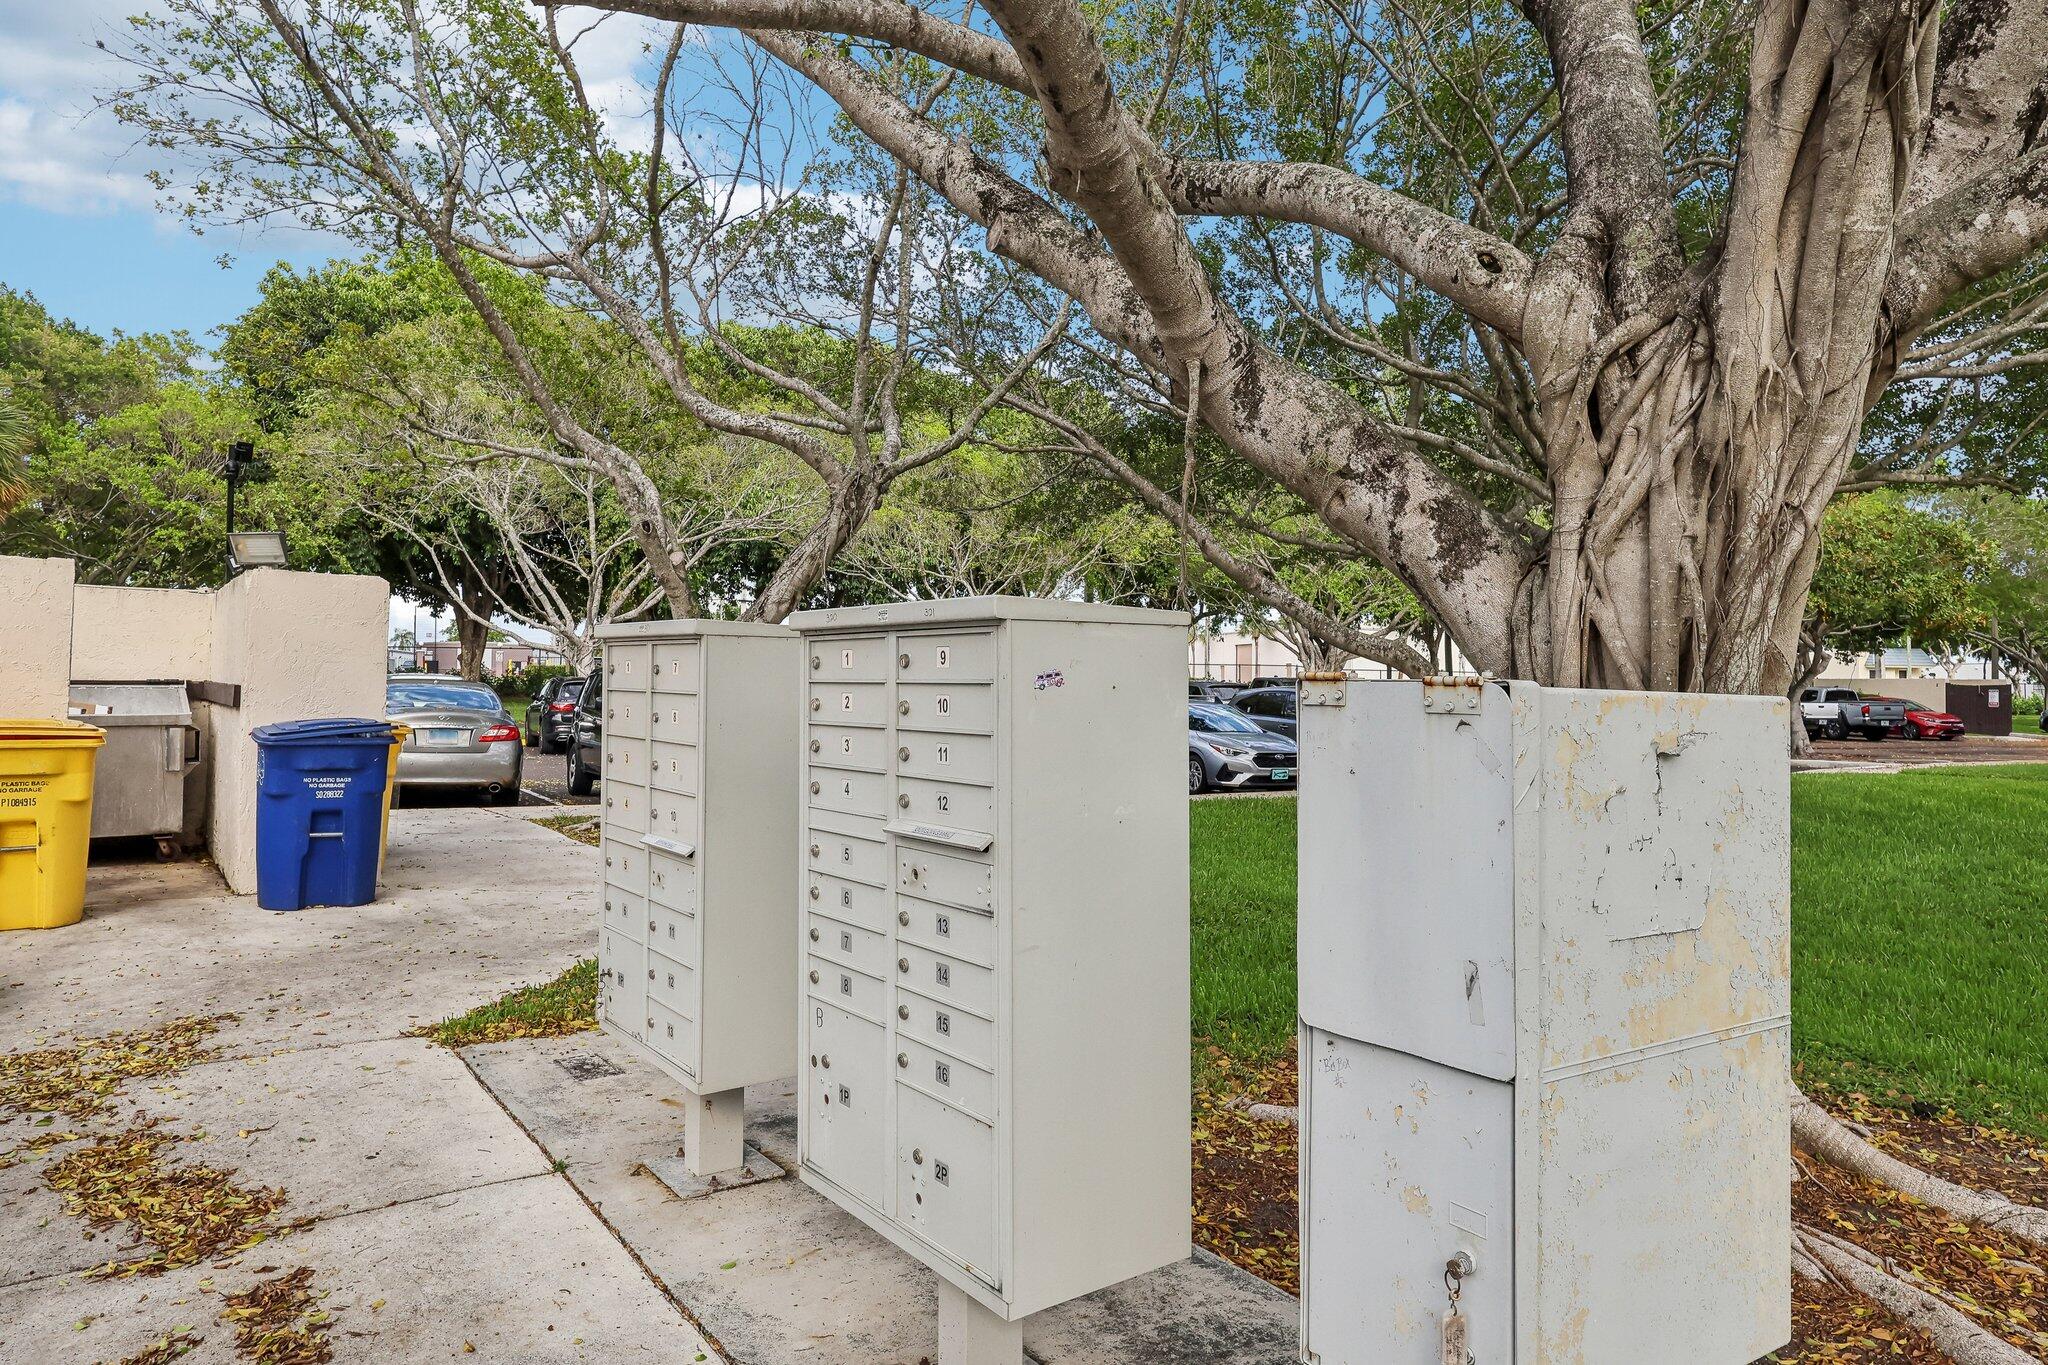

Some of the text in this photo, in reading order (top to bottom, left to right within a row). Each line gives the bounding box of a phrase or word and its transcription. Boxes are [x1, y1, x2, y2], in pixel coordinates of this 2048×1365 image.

[844, 652, 850, 667] 1
[939, 649, 947, 666] 9
[844, 695, 851, 710] 2
[937, 697, 949, 714] 10
[844, 738, 851, 753] 3
[937, 746, 949, 763] 11
[843, 781, 851, 797] 4
[937, 795, 949, 812] 12
[844, 847, 850, 861] 5
[843, 890, 850, 905] 6
[937, 917, 948, 934] 13
[843, 934, 850, 949] 7
[937, 966, 948, 983] 14
[843, 978, 850, 993] 8
[816, 1007, 823, 1028] B
[937, 1015, 948, 1032] 15
[937, 1065, 948, 1083] 16
[839, 1087, 850, 1104] 1P
[936, 1164, 947, 1181] 2P
